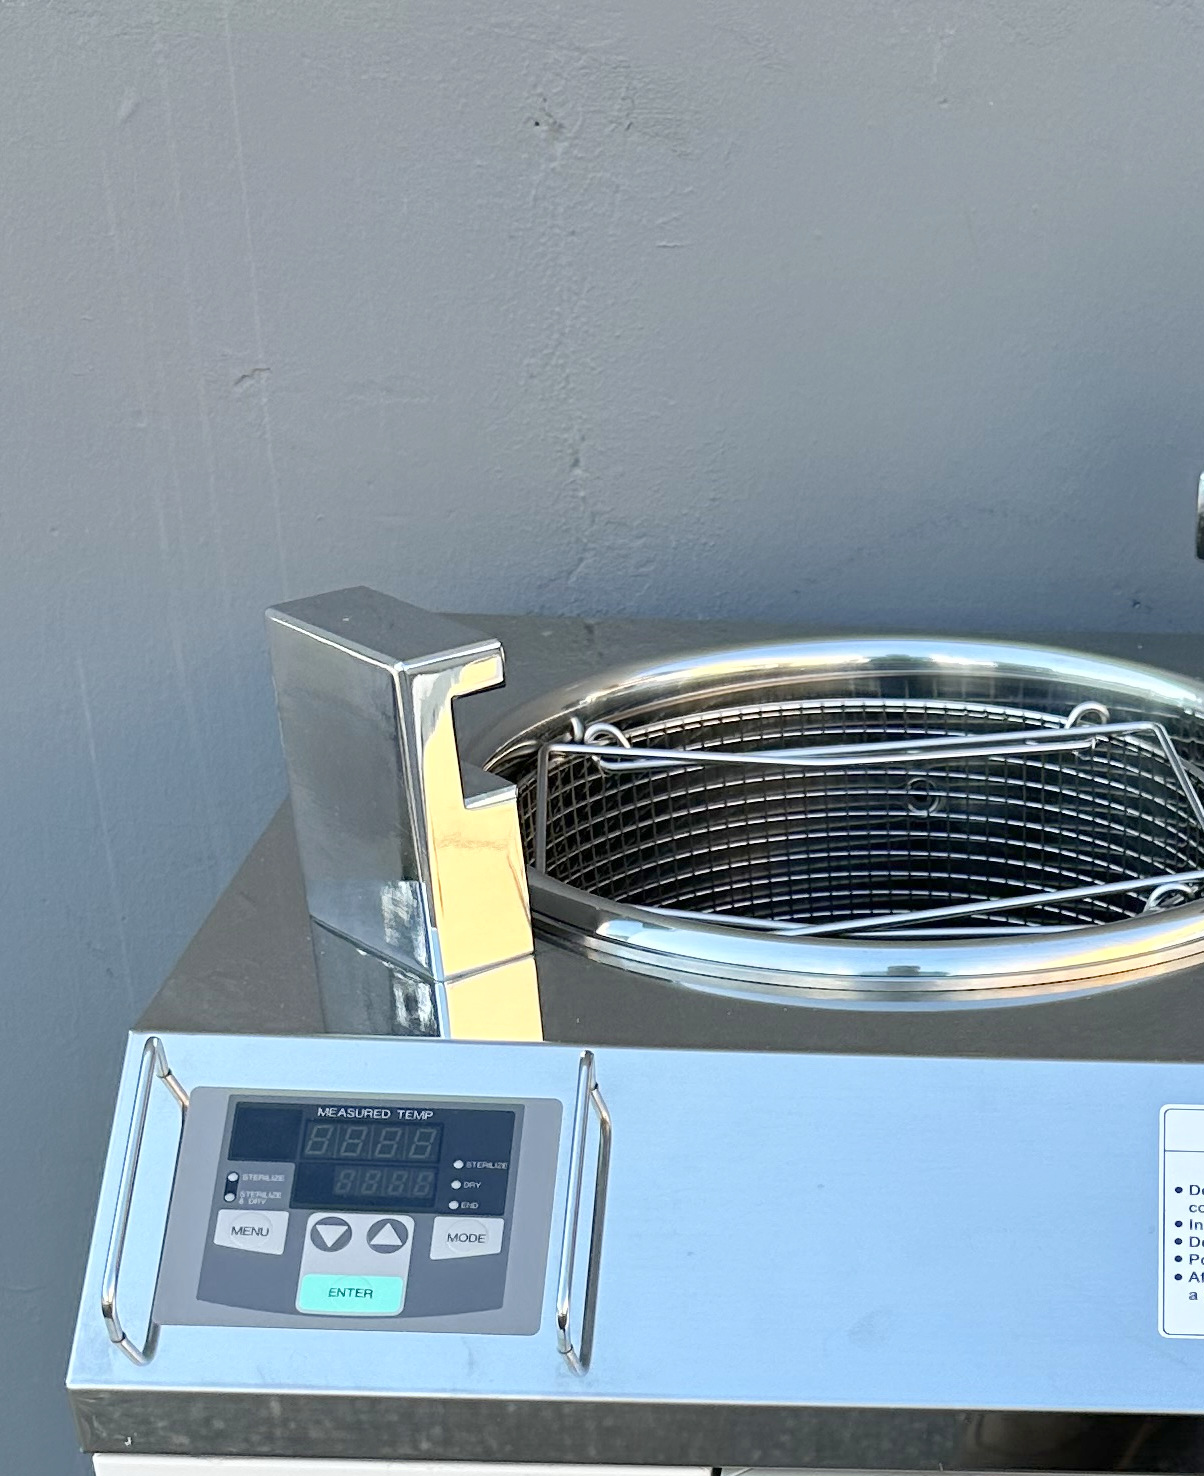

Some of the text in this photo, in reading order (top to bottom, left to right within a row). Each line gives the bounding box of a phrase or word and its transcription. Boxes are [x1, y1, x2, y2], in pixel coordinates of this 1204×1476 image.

[317, 1107, 434, 1120] MEASURED TEMP
[231, 1226, 270, 1237] MENU
[447, 1233, 486, 1243] MODE
[328, 1288, 373, 1299] ENTER
[1189, 1291, 1198, 1301] a
